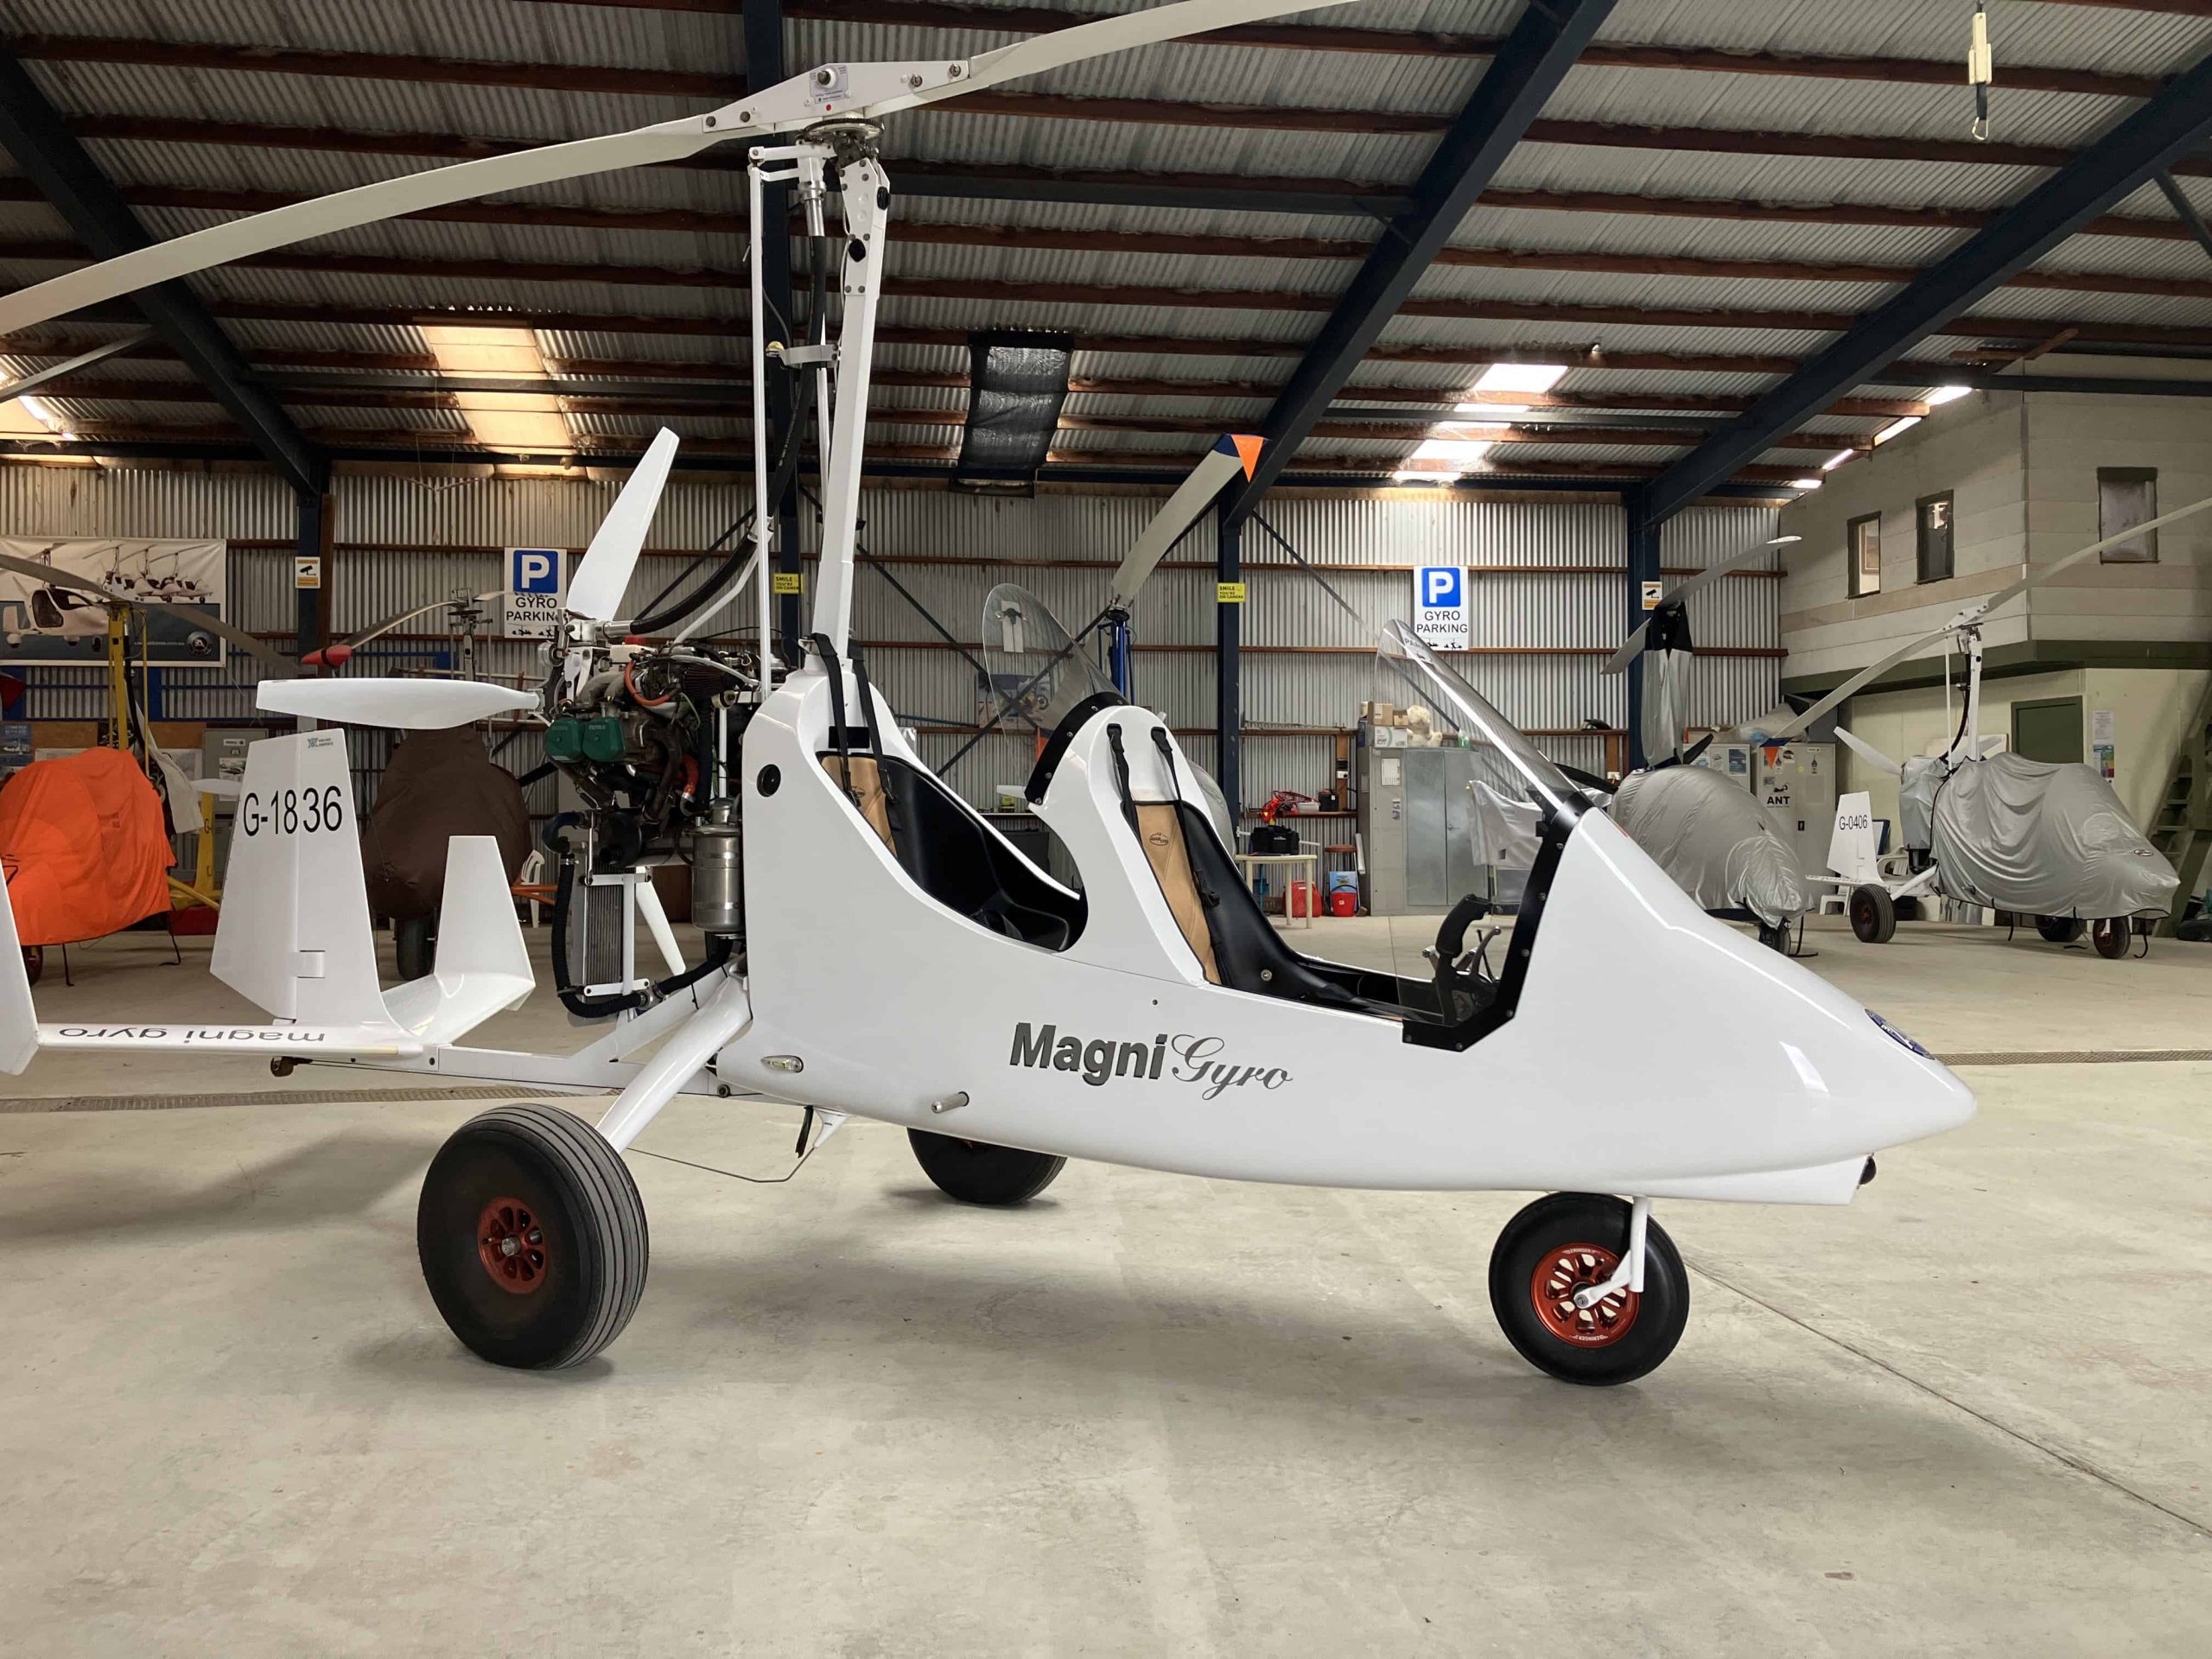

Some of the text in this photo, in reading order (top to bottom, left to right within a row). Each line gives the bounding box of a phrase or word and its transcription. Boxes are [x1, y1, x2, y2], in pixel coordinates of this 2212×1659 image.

[521, 555, 550, 589] P
[1428, 571, 1454, 604] P
[515, 596, 557, 609] GYRO
[506, 611, 556, 622] PARKIN
[1424, 610, 1461, 621] GYRO
[1416, 623, 1468, 633] PARKING
[1767, 796, 1791, 805] ANT
[243, 785, 343, 837] G-1836
[1839, 814, 1868, 830] G-0406
[59, 1027, 326, 1044] magni gyro
